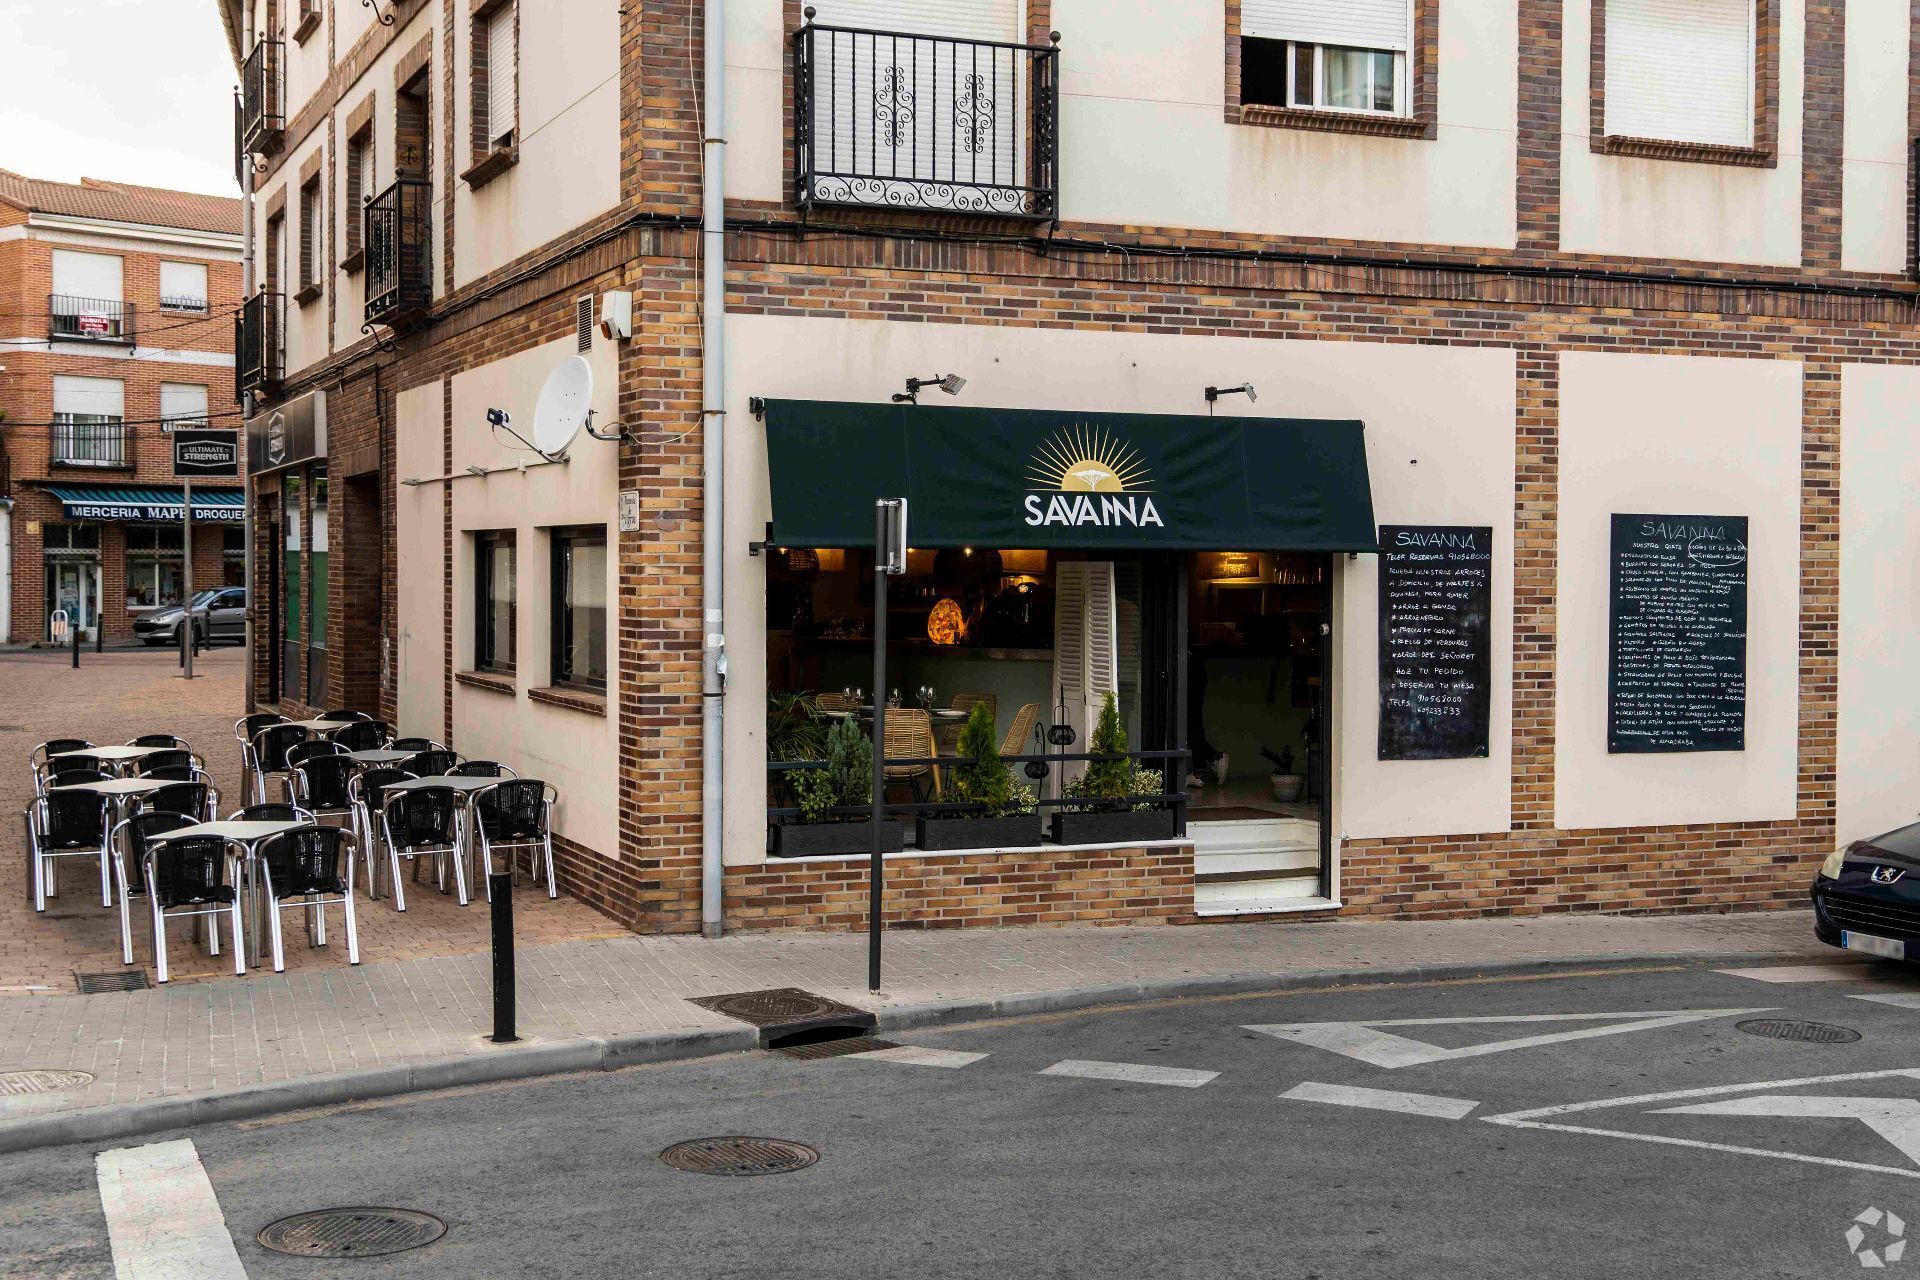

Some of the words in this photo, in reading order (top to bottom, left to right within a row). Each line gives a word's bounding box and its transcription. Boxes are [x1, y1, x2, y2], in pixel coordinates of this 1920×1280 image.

[184, 453, 230, 461] STRENGTH
[72, 506, 142, 518] MERCERIA
[1024, 494, 1164, 527] SAVANNA
[1640, 521, 1726, 540] SAVANNA
[1395, 531, 1476, 550] SAVANNA
[1409, 553, 1444, 561] RESERVAS
[1436, 639, 1468, 647] VERDURAS
[1396, 667, 1412, 675] HAZ
[1419, 667, 1429, 675] TU
[1434, 667, 1464, 675] PEDIDO
[1453, 682, 1475, 690] MESA
